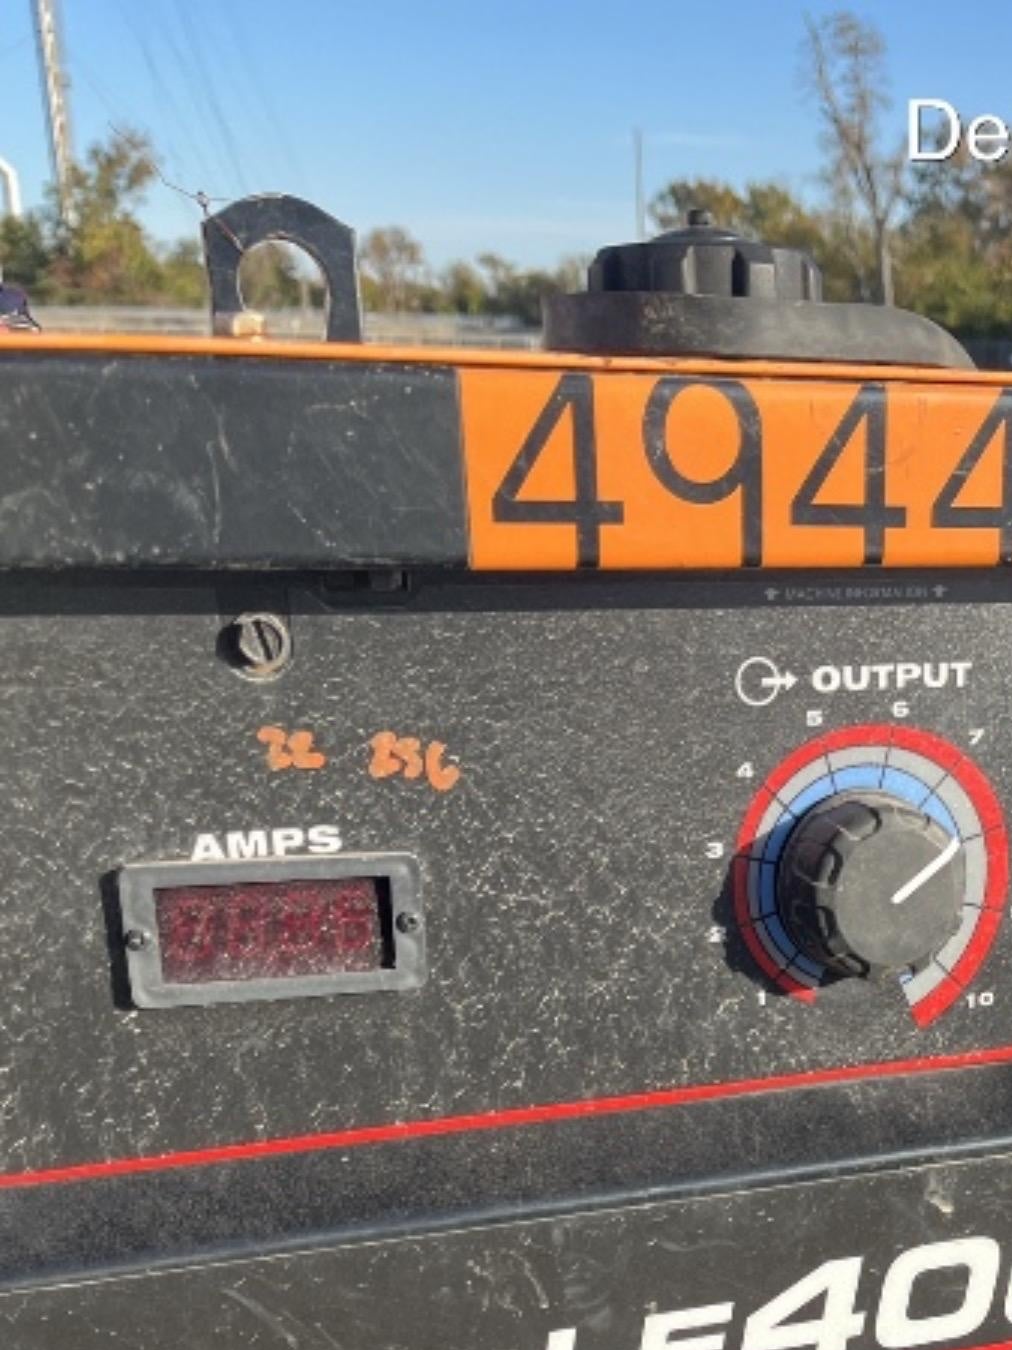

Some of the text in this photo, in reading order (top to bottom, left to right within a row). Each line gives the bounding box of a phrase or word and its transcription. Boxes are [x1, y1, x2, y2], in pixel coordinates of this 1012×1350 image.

[812, 662, 973, 692] OUTPUT
[892, 701, 910, 718] 6
[805, 710, 824, 727] 5
[968, 728, 985, 745] 7
[736, 761, 754, 779] 4
[191, 824, 343, 861] AMPS
[705, 842, 724, 859] 3
[966, 991, 994, 1009] 10
